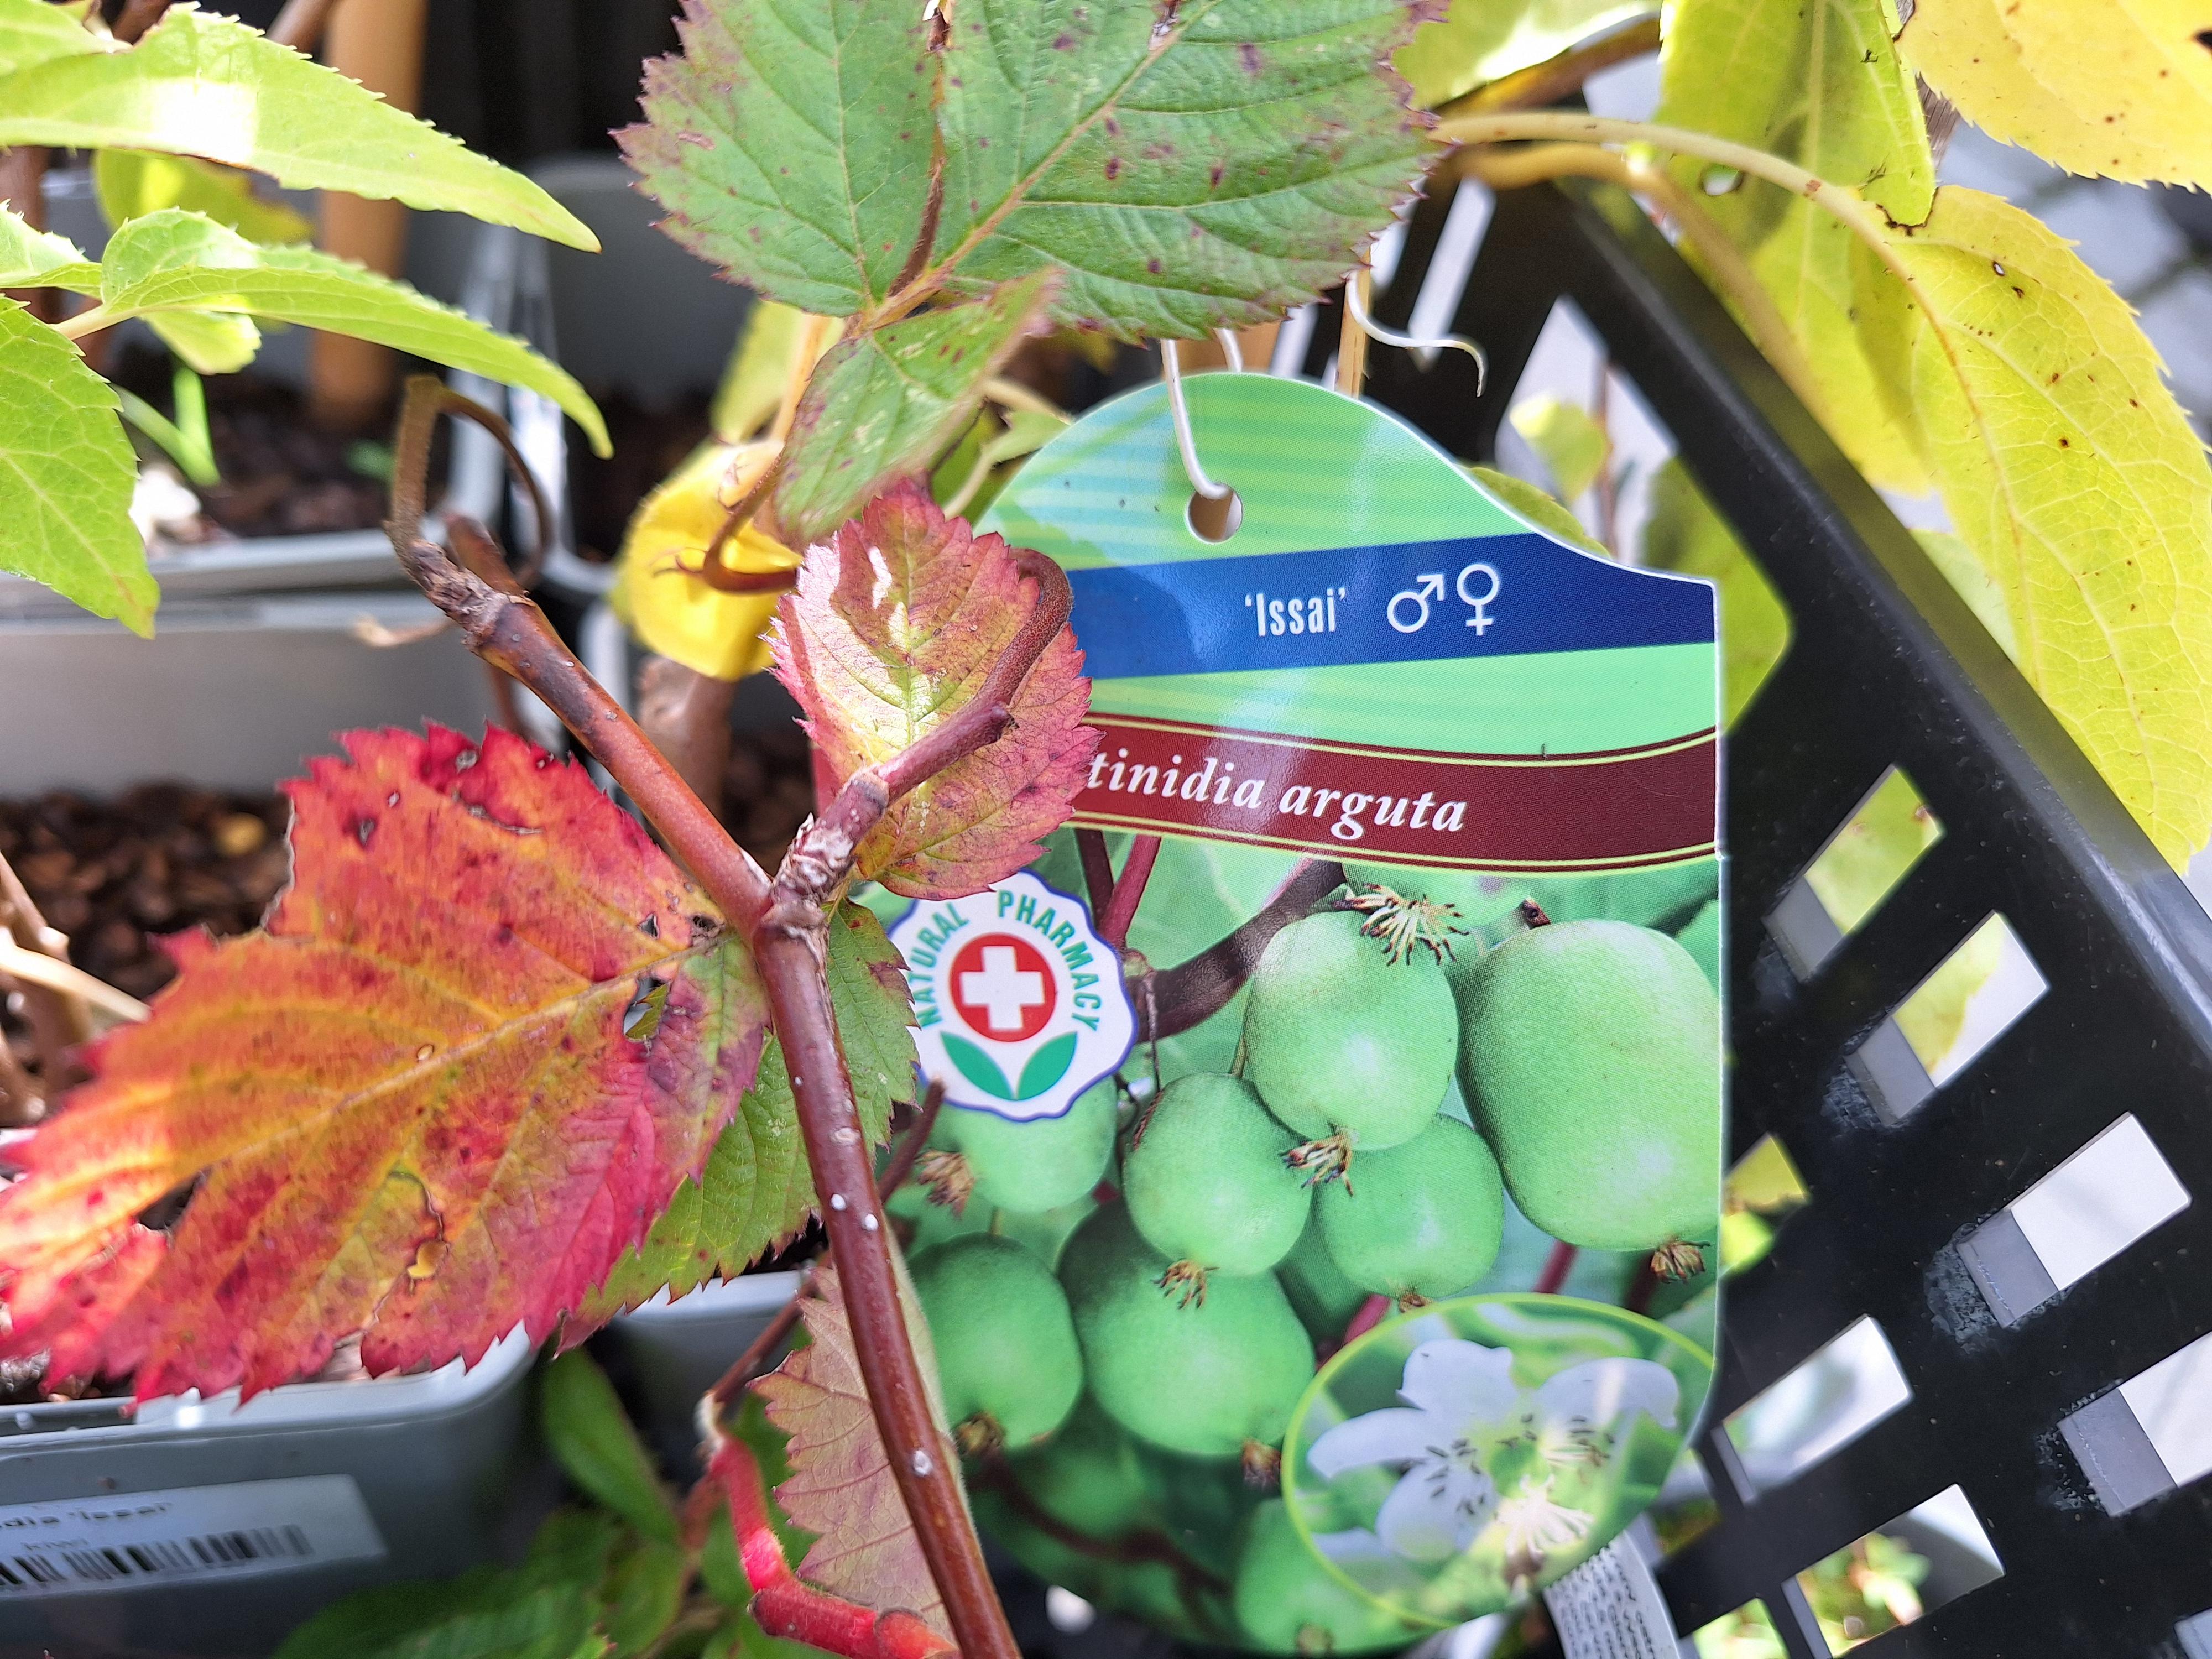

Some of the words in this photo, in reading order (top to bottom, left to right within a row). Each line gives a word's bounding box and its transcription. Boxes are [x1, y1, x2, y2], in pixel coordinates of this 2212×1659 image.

[1244, 585, 1345, 637] ‘Issai’
[1086, 747, 1264, 809] tinidia
[1278, 785, 1467, 840] arguta
[909, 902, 969, 1029] NATURAL
[997, 889, 1102, 1032] PHARMACY
